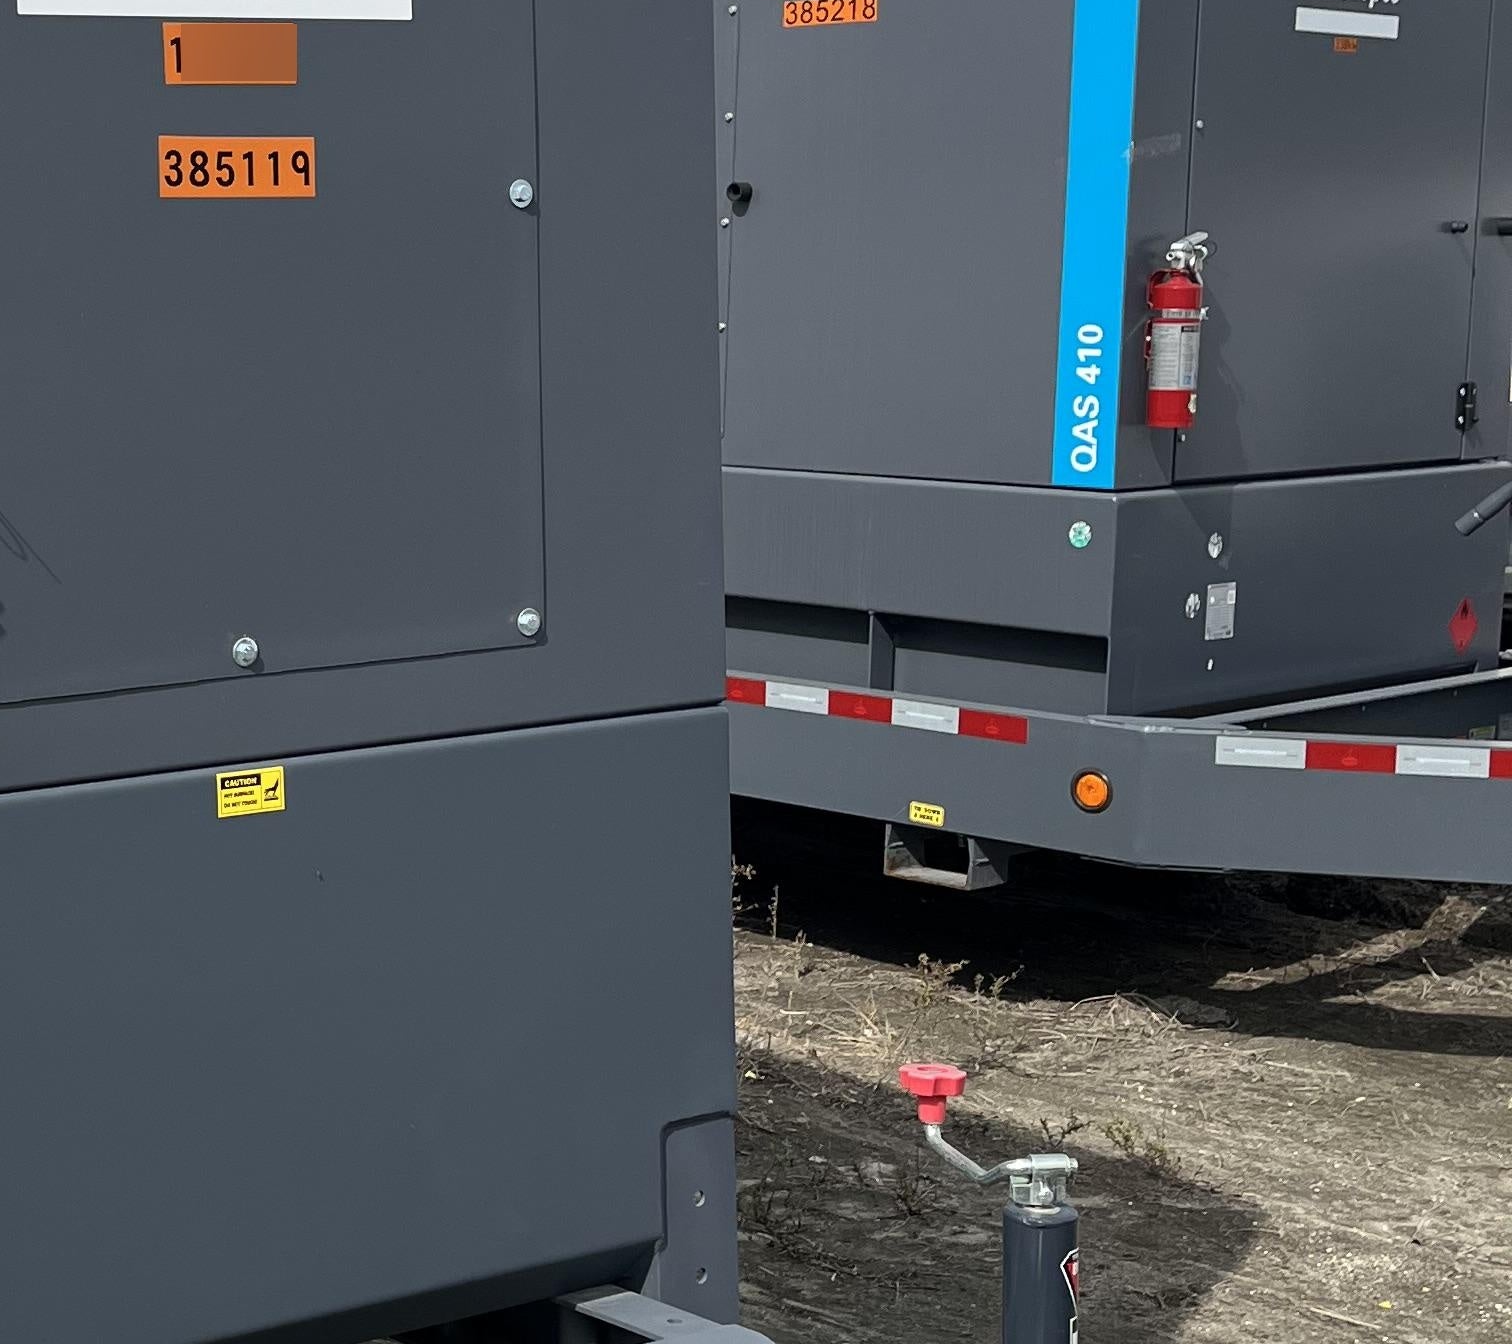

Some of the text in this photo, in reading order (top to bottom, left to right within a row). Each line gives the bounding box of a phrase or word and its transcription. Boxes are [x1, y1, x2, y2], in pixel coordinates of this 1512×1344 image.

[163, 148, 311, 187] 385119
[1070, 323, 1104, 473] QAS 410
[224, 777, 257, 788] CAUTION
